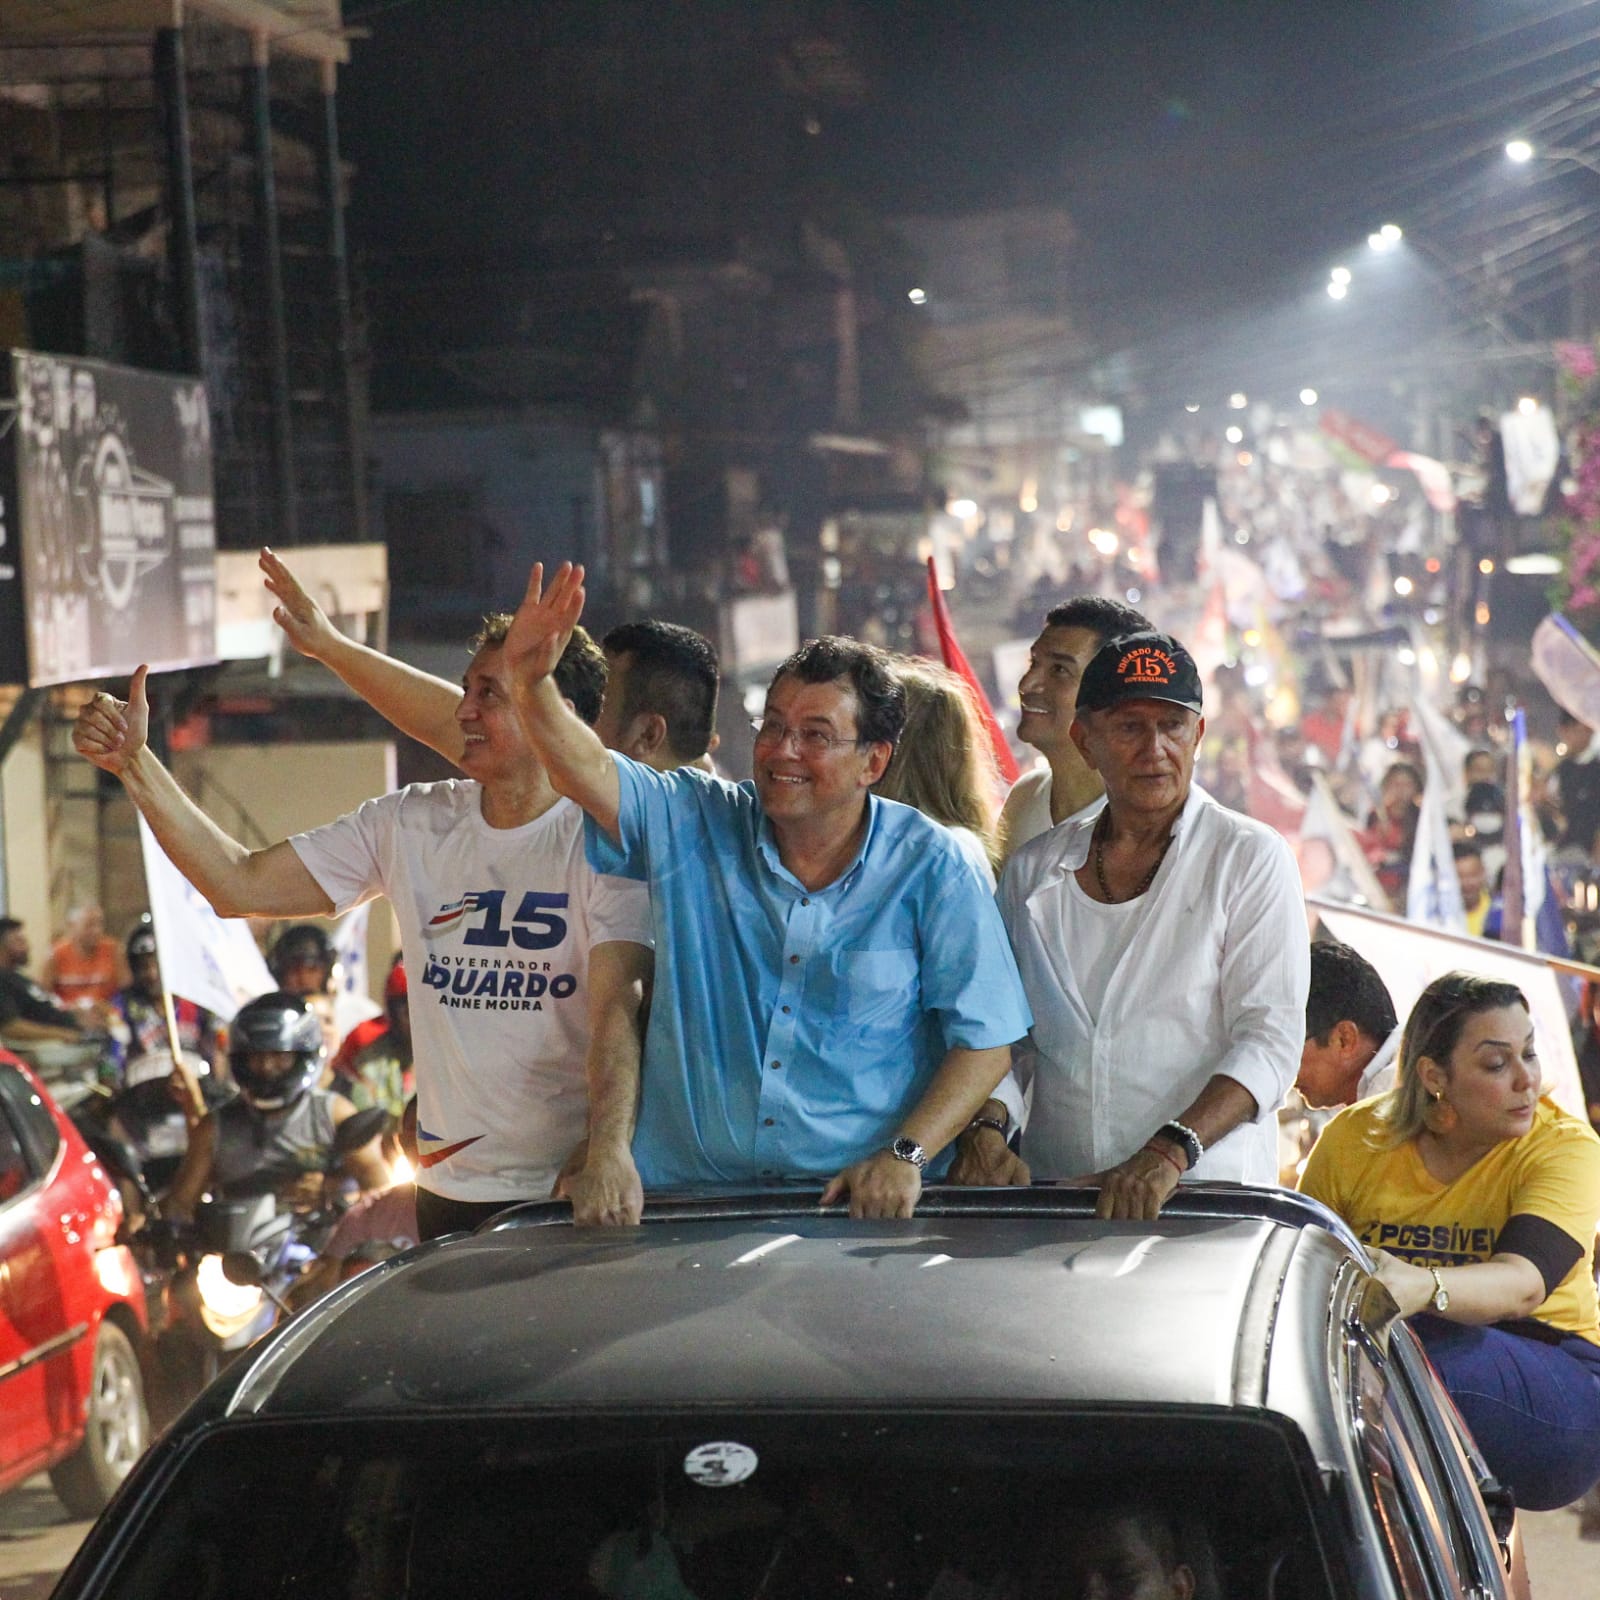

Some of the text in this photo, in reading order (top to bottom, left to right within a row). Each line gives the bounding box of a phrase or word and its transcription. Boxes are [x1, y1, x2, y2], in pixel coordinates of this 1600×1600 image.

[1131, 657, 1161, 676] 15
[462, 890, 569, 950] 15
[429, 953, 551, 971] GOVERNADOR
[439, 994, 543, 1011] ANNE MOURA
